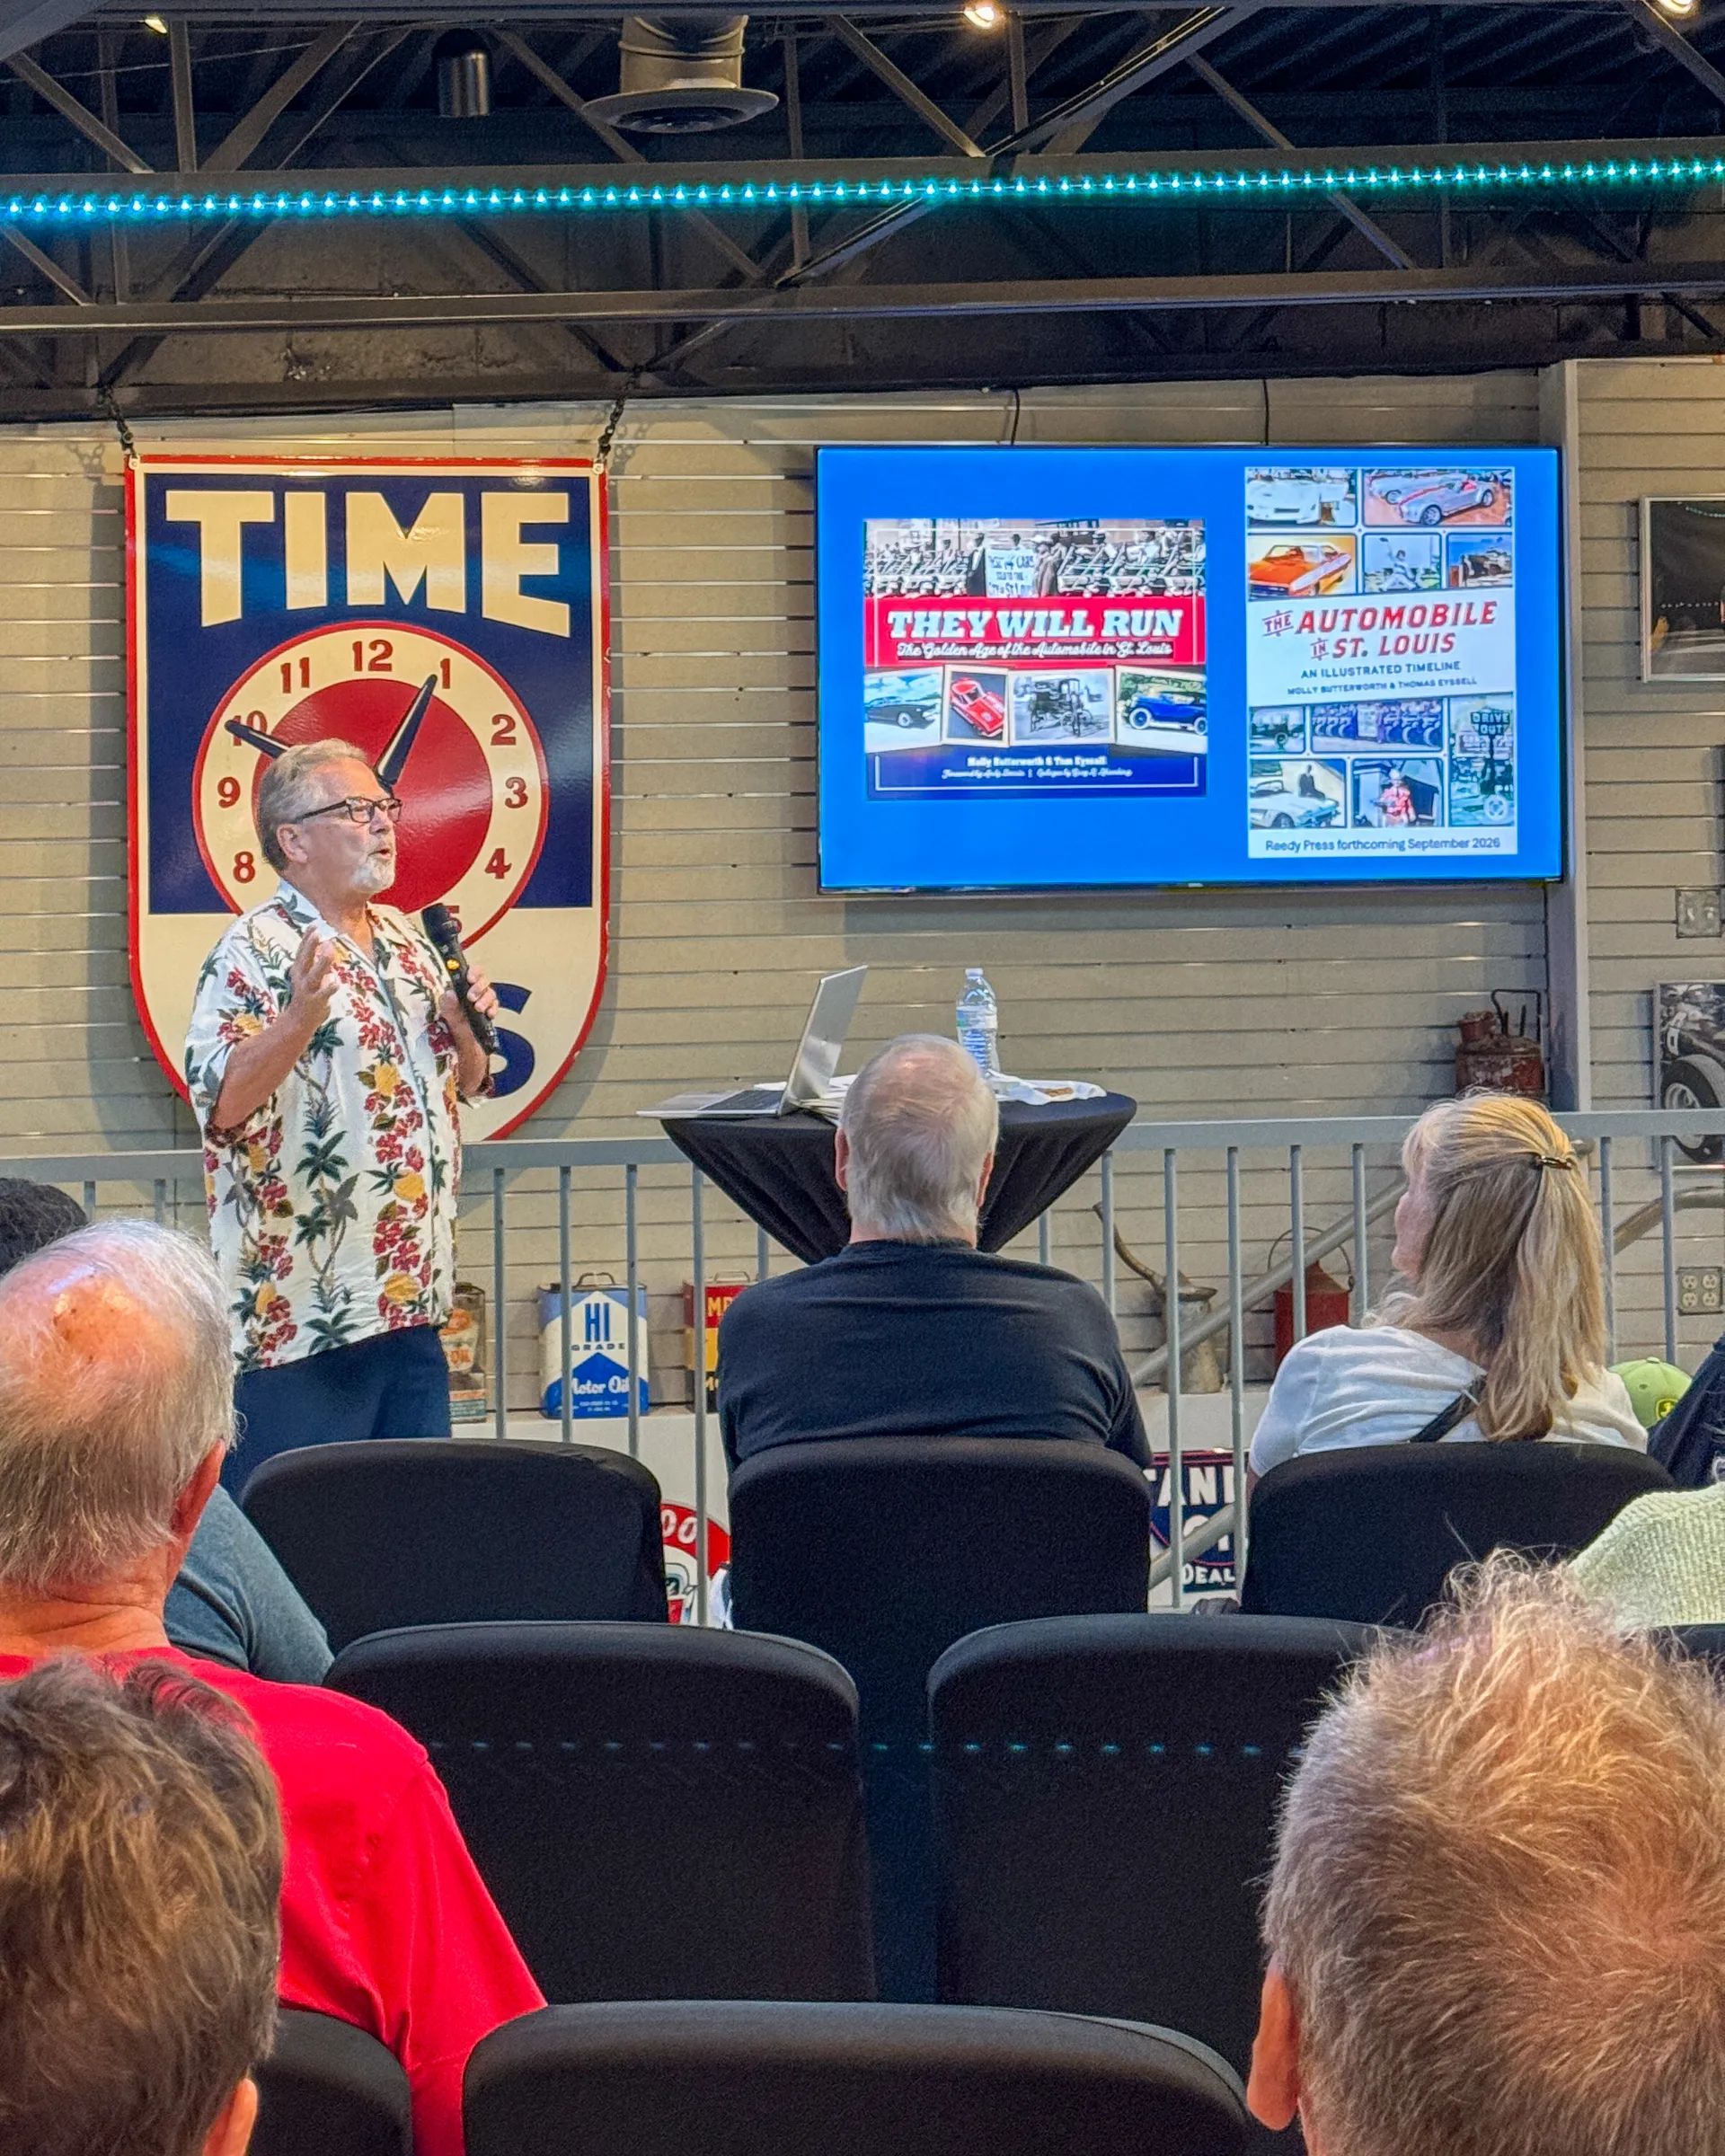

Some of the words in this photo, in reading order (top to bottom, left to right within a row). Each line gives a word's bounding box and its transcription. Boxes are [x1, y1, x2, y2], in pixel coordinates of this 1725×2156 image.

[165, 490, 571, 638] TIME
[887, 609, 994, 639] THEY
[995, 609, 1094, 639] WILL
[1101, 609, 1184, 638] RUN
[1264, 614, 1292, 632] THE
[1295, 601, 1498, 635] AUTOMOBILE
[352, 639, 394, 672] 12
[897, 641, 922, 657] The
[922, 641, 968, 659] Golden
[969, 641, 996, 658] Age
[997, 641, 1012, 658] of
[1011, 641, 1032, 656] the
[1031, 641, 1101, 658] Automobile
[1101, 641, 1117, 656] in
[1136, 641, 1173, 656] Louis
[1313, 641, 1327, 657] IN
[1332, 637, 1368, 659] ST.
[1377, 632, 1456, 657] LOUIS
[280, 657, 310, 694] 11
[439, 658, 451, 690] 1
[1301, 668, 1318, 679] AN
[1321, 664, 1402, 679] ILLUSTRATED
[1405, 660, 1462, 674] TIMELINE
[1287, 685, 1318, 695] MOLLY
[1321, 682, 1388, 694] BUTTERWORTH
[1398, 679, 1436, 689] THOMAS
[491, 714, 518, 746] 2
[217, 776, 240, 808] 9
[505, 777, 529, 808] 3
[1265, 839, 1301, 853] Reedy
[1304, 839, 1334, 851] Press
[1337, 838, 1406, 853] forthcoming
[1408, 837, 1471, 852] September
[1472, 836, 1501, 849] 2026
[233, 851, 255, 883] 8
[485, 848, 511, 879] 4
[584, 1303, 610, 1342] HI
[570, 1342, 626, 1351] GRADE
